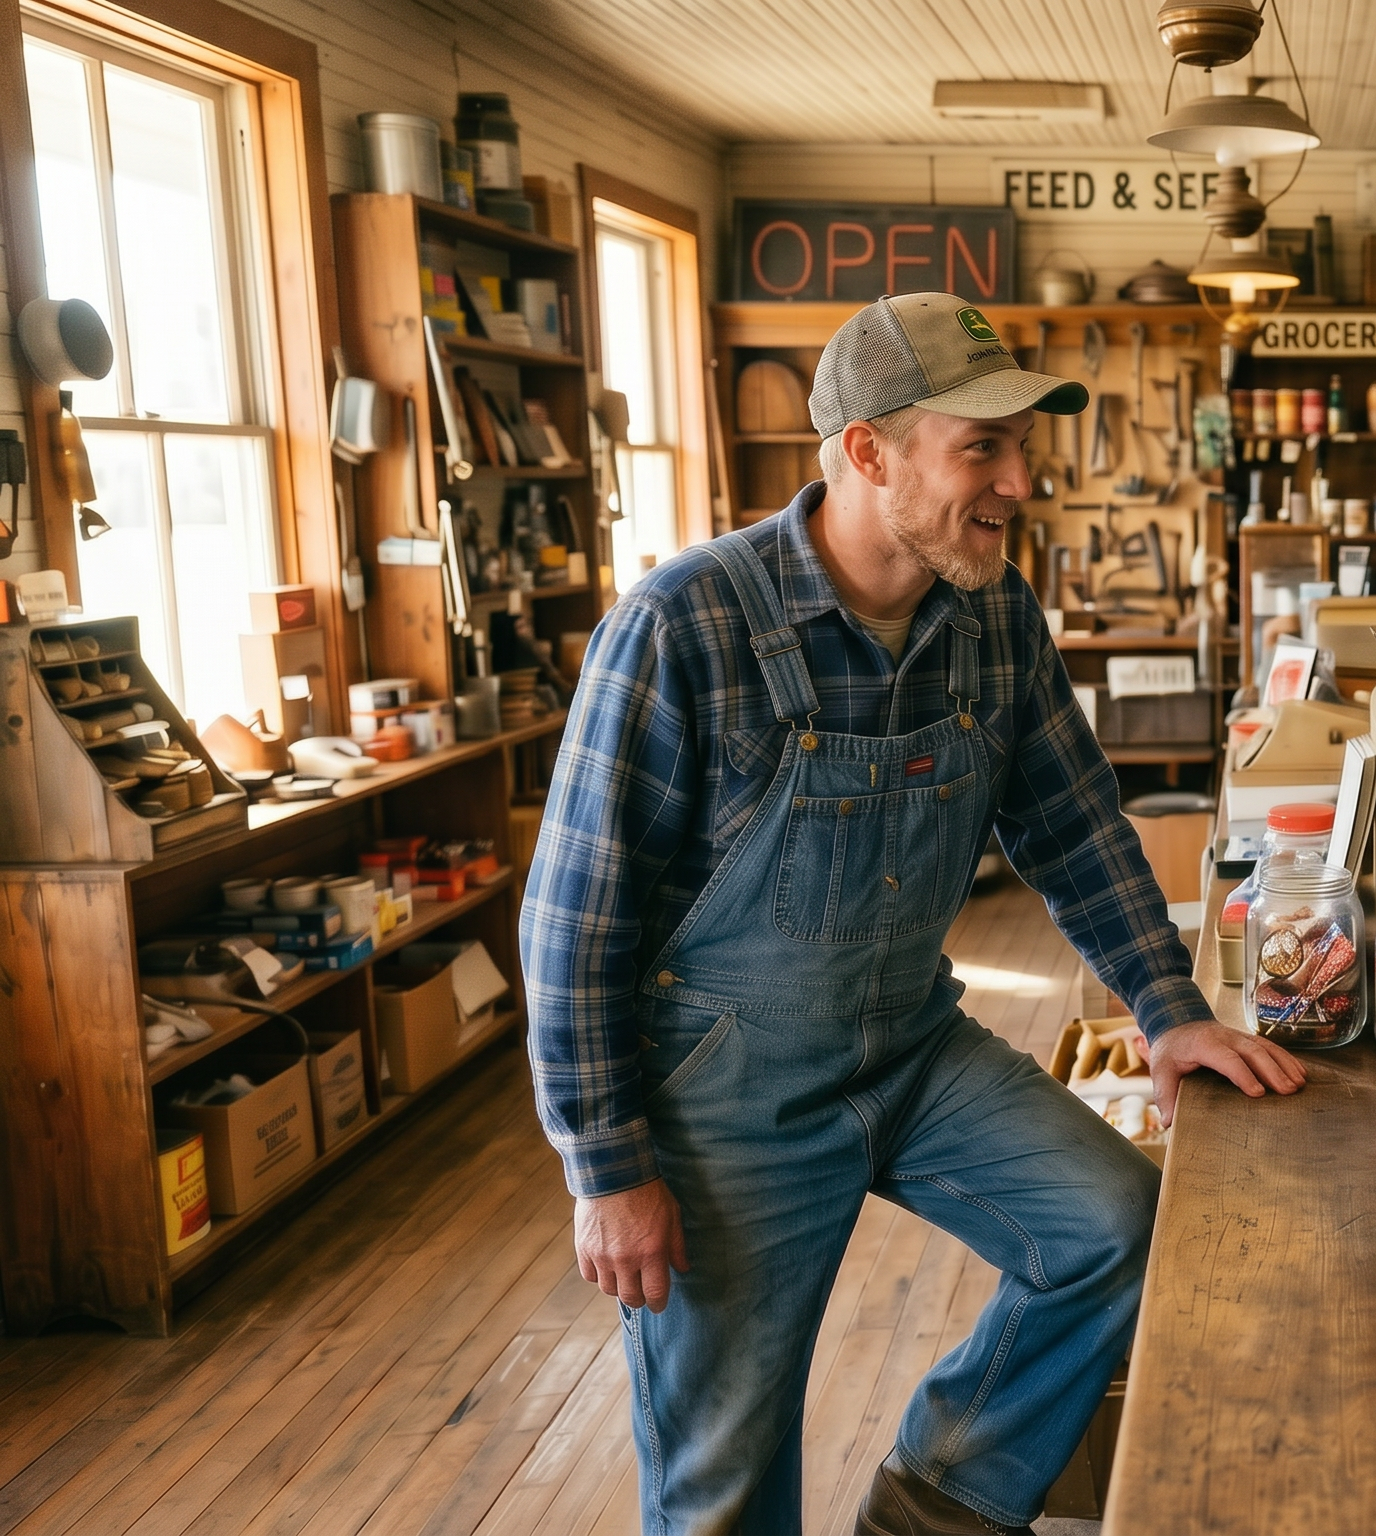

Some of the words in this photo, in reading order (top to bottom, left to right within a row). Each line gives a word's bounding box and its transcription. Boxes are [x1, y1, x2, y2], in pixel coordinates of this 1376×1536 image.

[1004, 171, 1095, 209] FEED
[1112, 172, 1137, 210] &
[1154, 173, 1221, 210] SEE
[752, 220, 997, 299] OPEN
